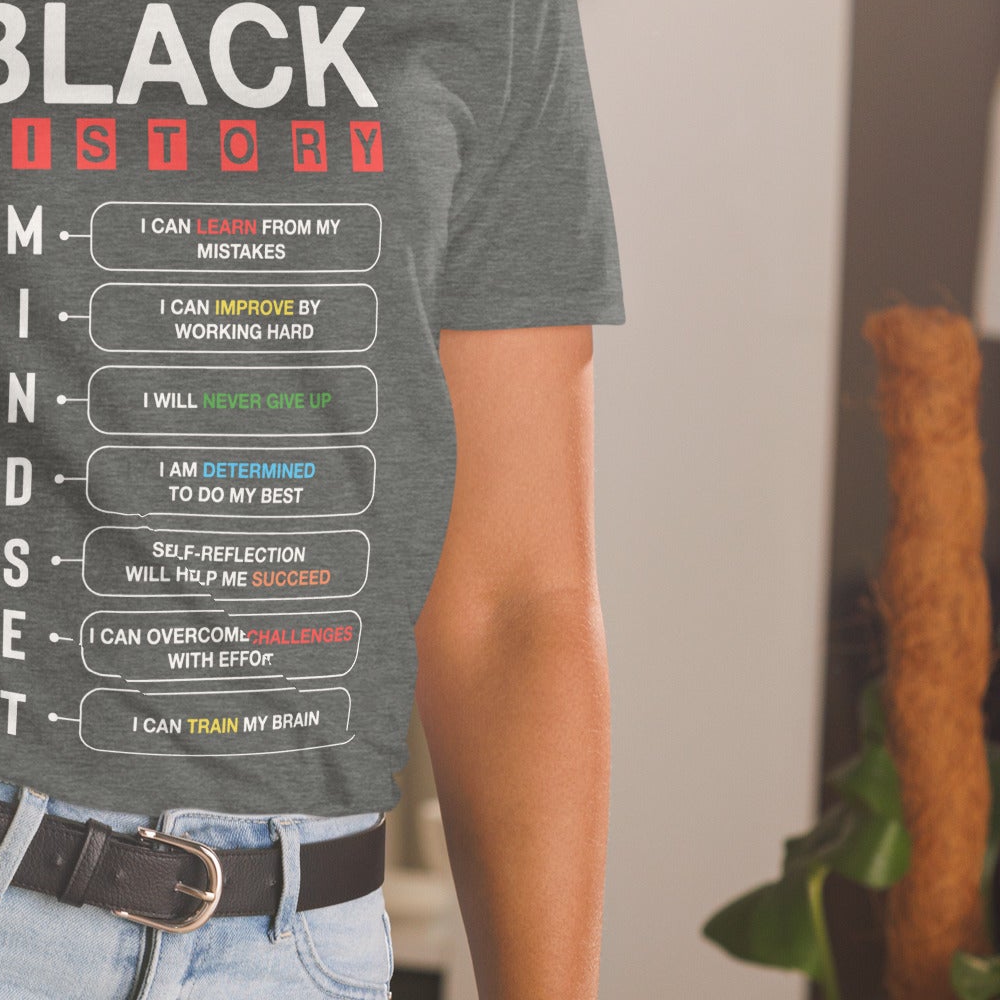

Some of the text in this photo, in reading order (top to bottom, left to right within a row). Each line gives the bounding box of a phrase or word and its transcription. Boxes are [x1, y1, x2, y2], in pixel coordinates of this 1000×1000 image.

[141, 217, 341, 236] I CAN LEARN FROM MY
[197, 242, 286, 260] MISTAKES
[160, 298, 321, 316] I CAN IMPROVE BY
[174, 323, 314, 340] WORKING HARD
[143, 392, 331, 409] I WILL NEVER GIVE UP
[0, 204, 43, 736] MINDSET
[159, 461, 316, 479] I AM DETERMINED
[168, 485, 304, 504] TO DO MY BEST
[125, 565, 171, 582] WILL
[221, 570, 248, 587] ME
[251, 569, 331, 588] SUCCEED
[89, 627, 95, 644] I
[100, 627, 142, 645] CAN
[246, 627, 354, 646] CHALLENGES
[167, 651, 214, 670] WITH
[132, 710, 320, 734] I CAN TRAIN MY BRAIN
